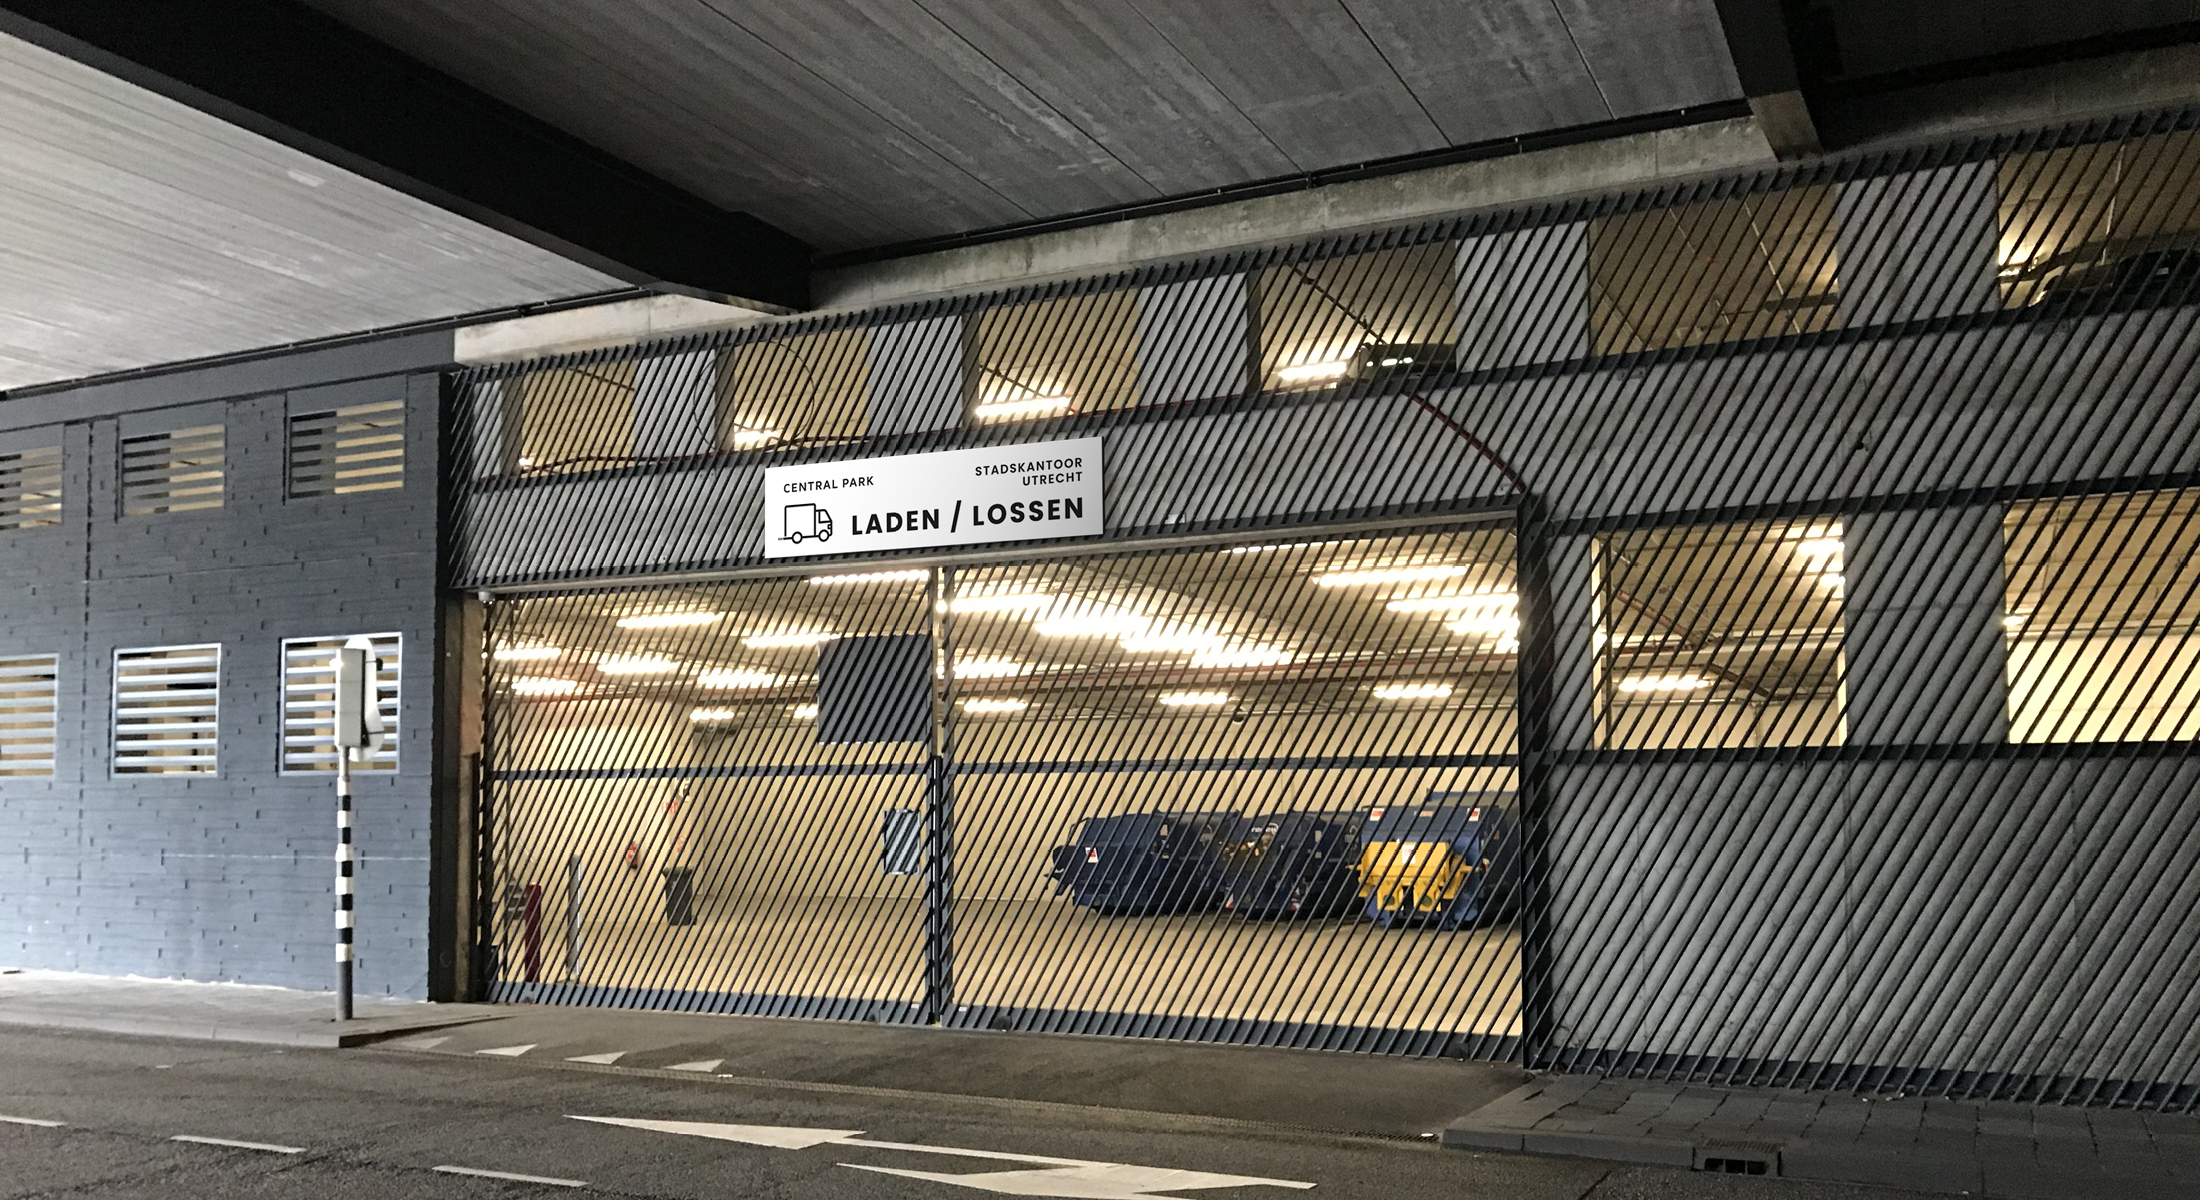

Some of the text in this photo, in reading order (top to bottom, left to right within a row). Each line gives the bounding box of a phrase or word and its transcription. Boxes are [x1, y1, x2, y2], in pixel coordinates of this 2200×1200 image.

[975, 457, 1083, 477] STADSKANTOOR
[783, 475, 875, 493] CENTRAL PARK
[1022, 471, 1083, 487] UTRECHT
[852, 497, 1083, 536] LADEN / LOSSEN
